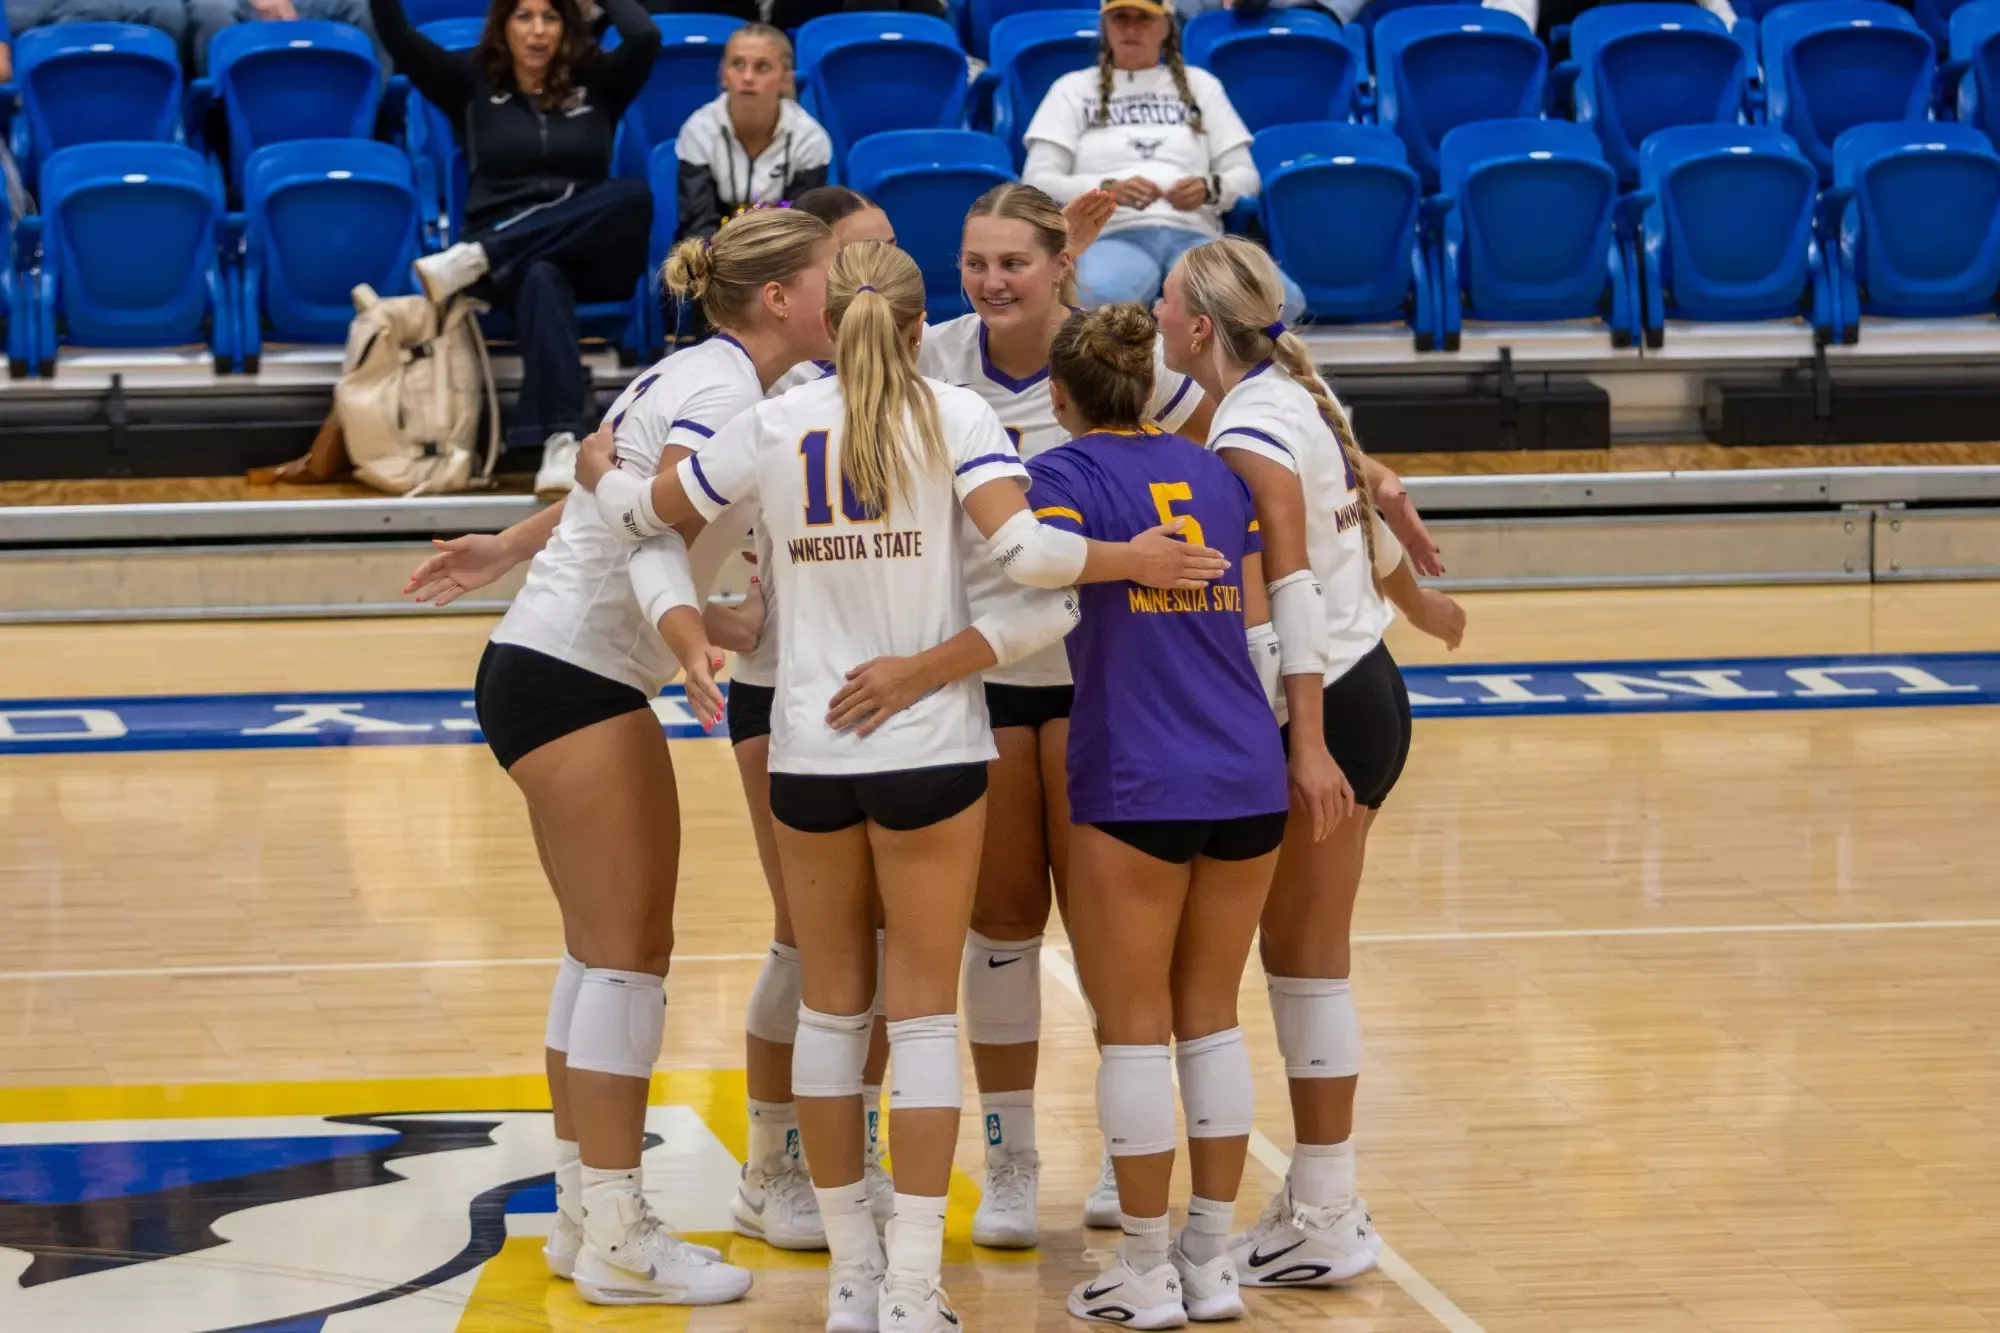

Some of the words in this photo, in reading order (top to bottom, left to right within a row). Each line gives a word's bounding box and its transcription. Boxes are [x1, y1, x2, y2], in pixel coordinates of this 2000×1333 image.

[1083, 102, 1192, 128] MVERICK
[787, 534, 868, 564] MNNESOTA
[873, 530, 922, 558] STATE
